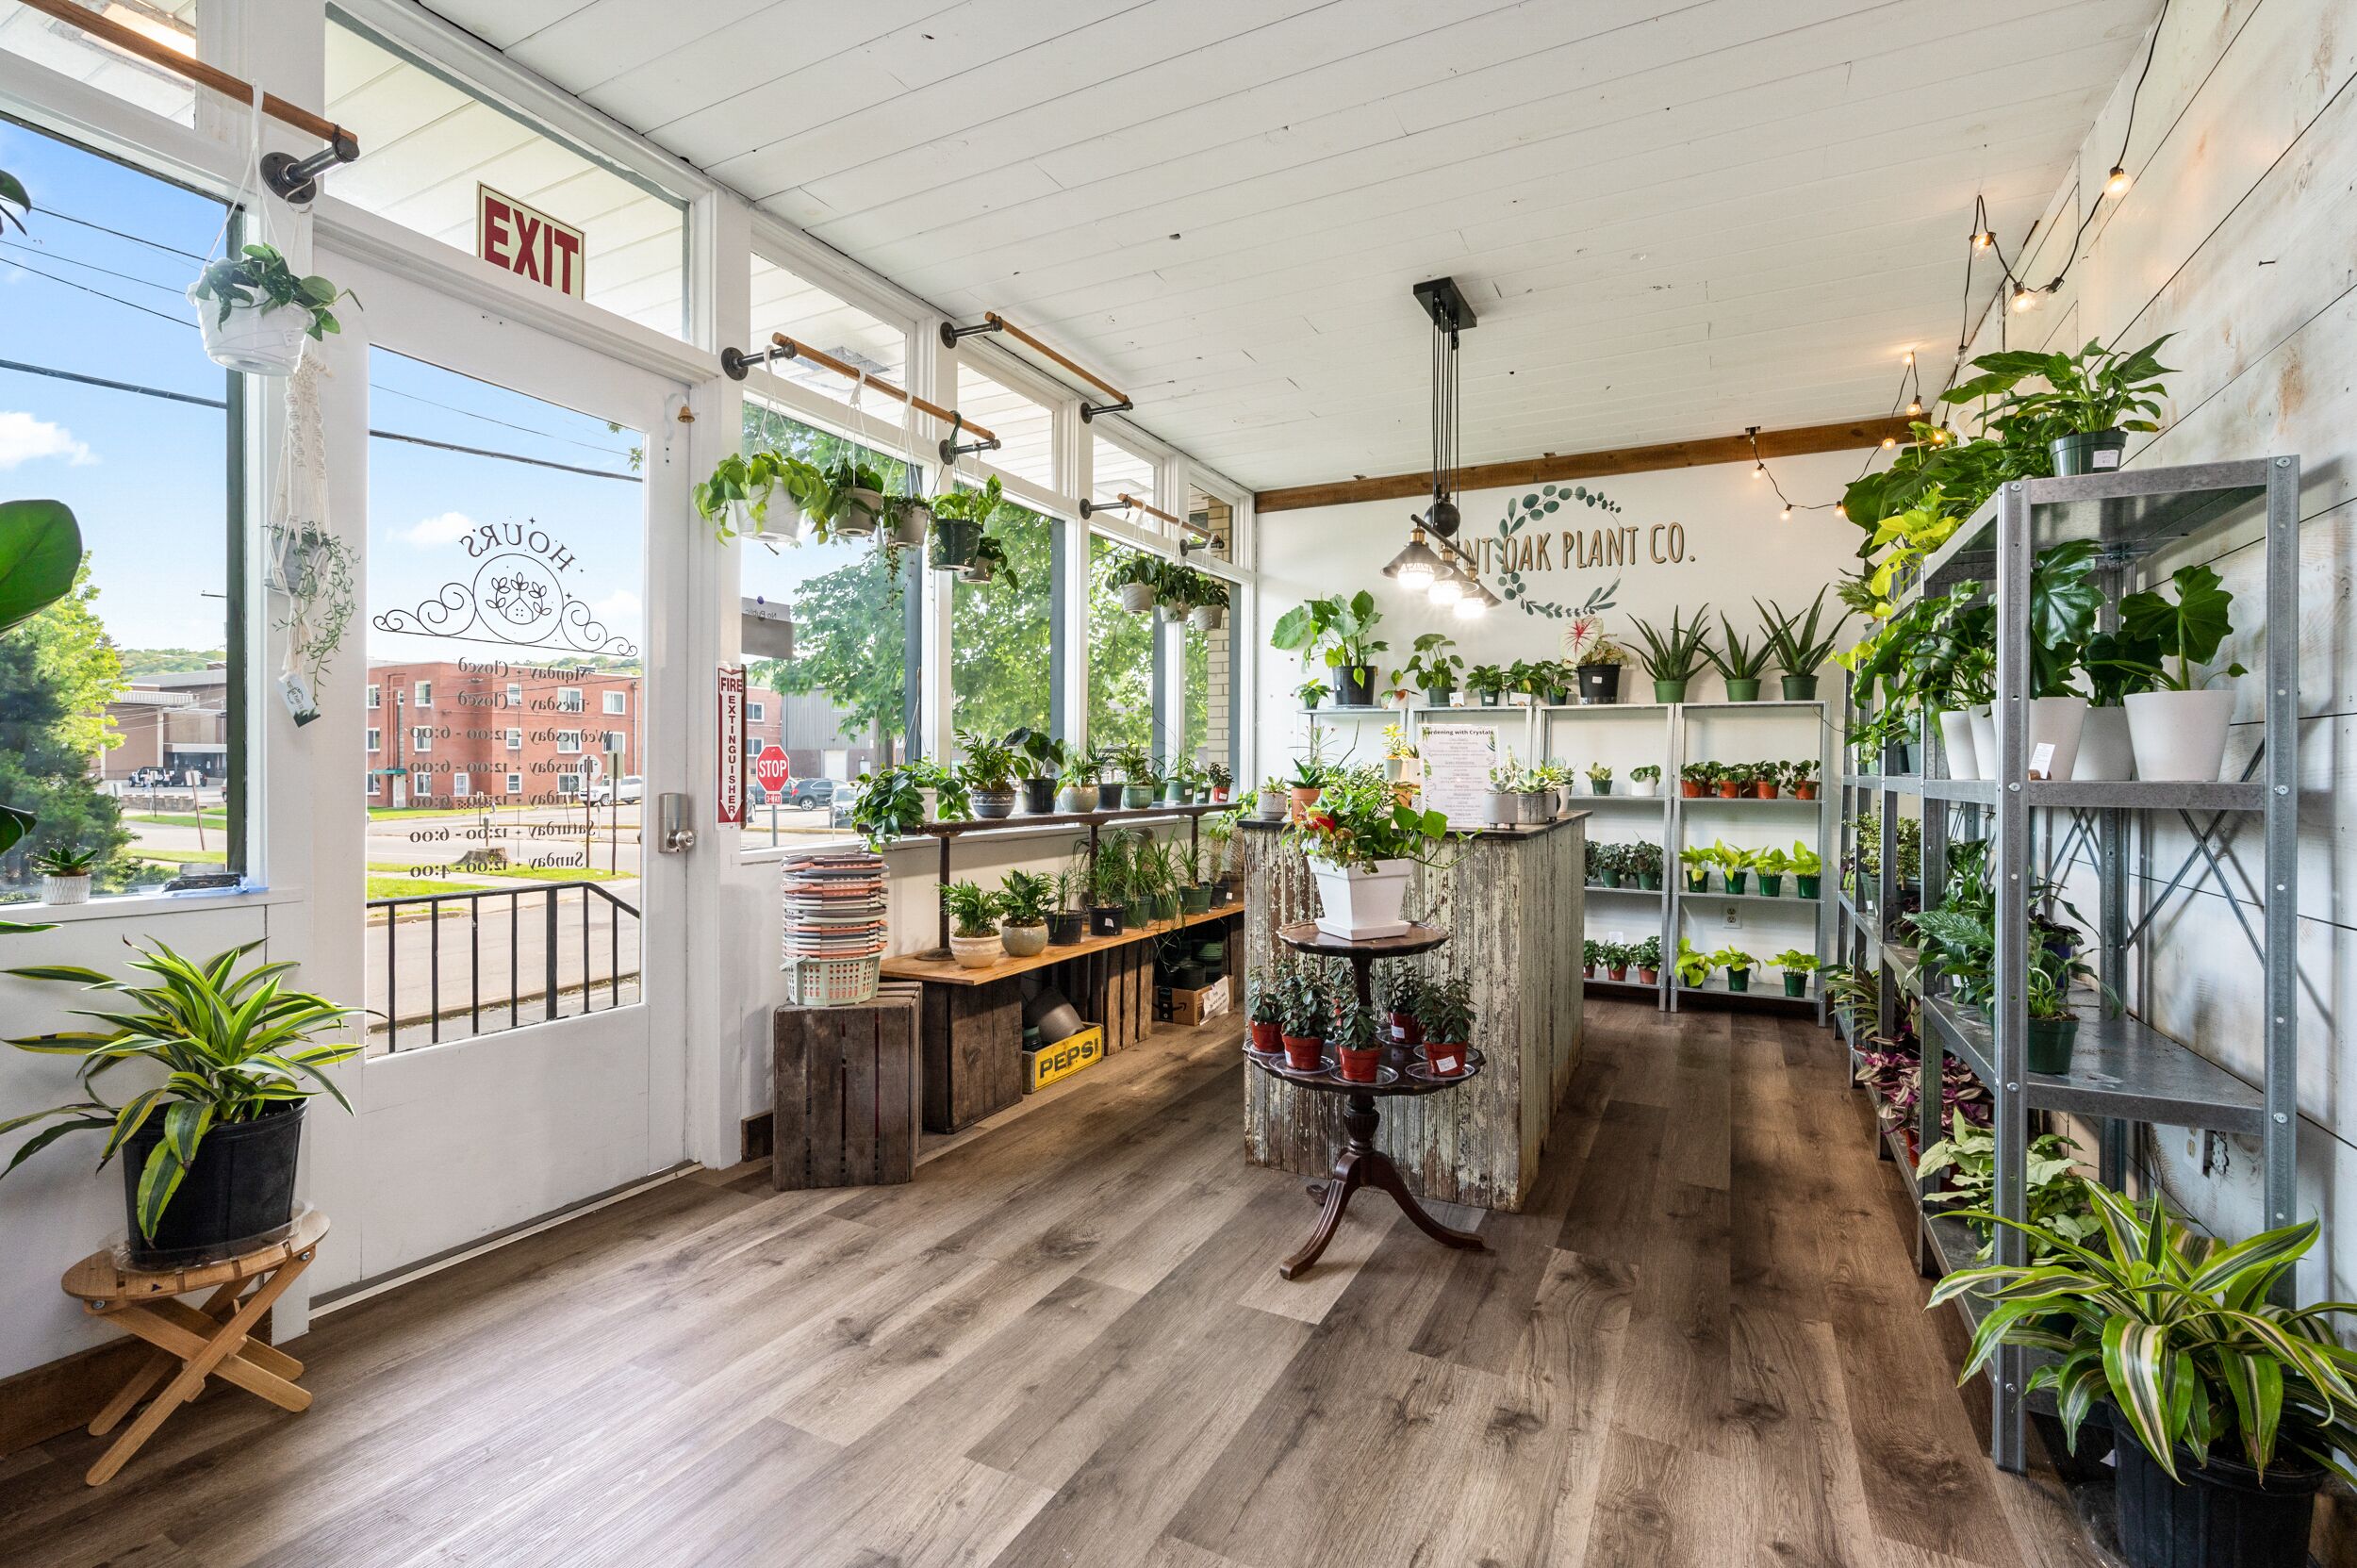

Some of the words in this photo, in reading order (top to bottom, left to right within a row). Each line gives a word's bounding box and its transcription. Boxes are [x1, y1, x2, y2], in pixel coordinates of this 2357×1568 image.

[484, 194, 580, 296] EXIT
[1502, 532, 1552, 574] OAK
[1561, 525, 1640, 569] PLANT
[1649, 521, 1696, 565] CO.
[720, 677, 743, 693] FIRE
[728, 695, 736, 814] EXTINGUISHER
[759, 760, 787, 778] STOP
[1039, 1037, 1099, 1080] PEPSI
